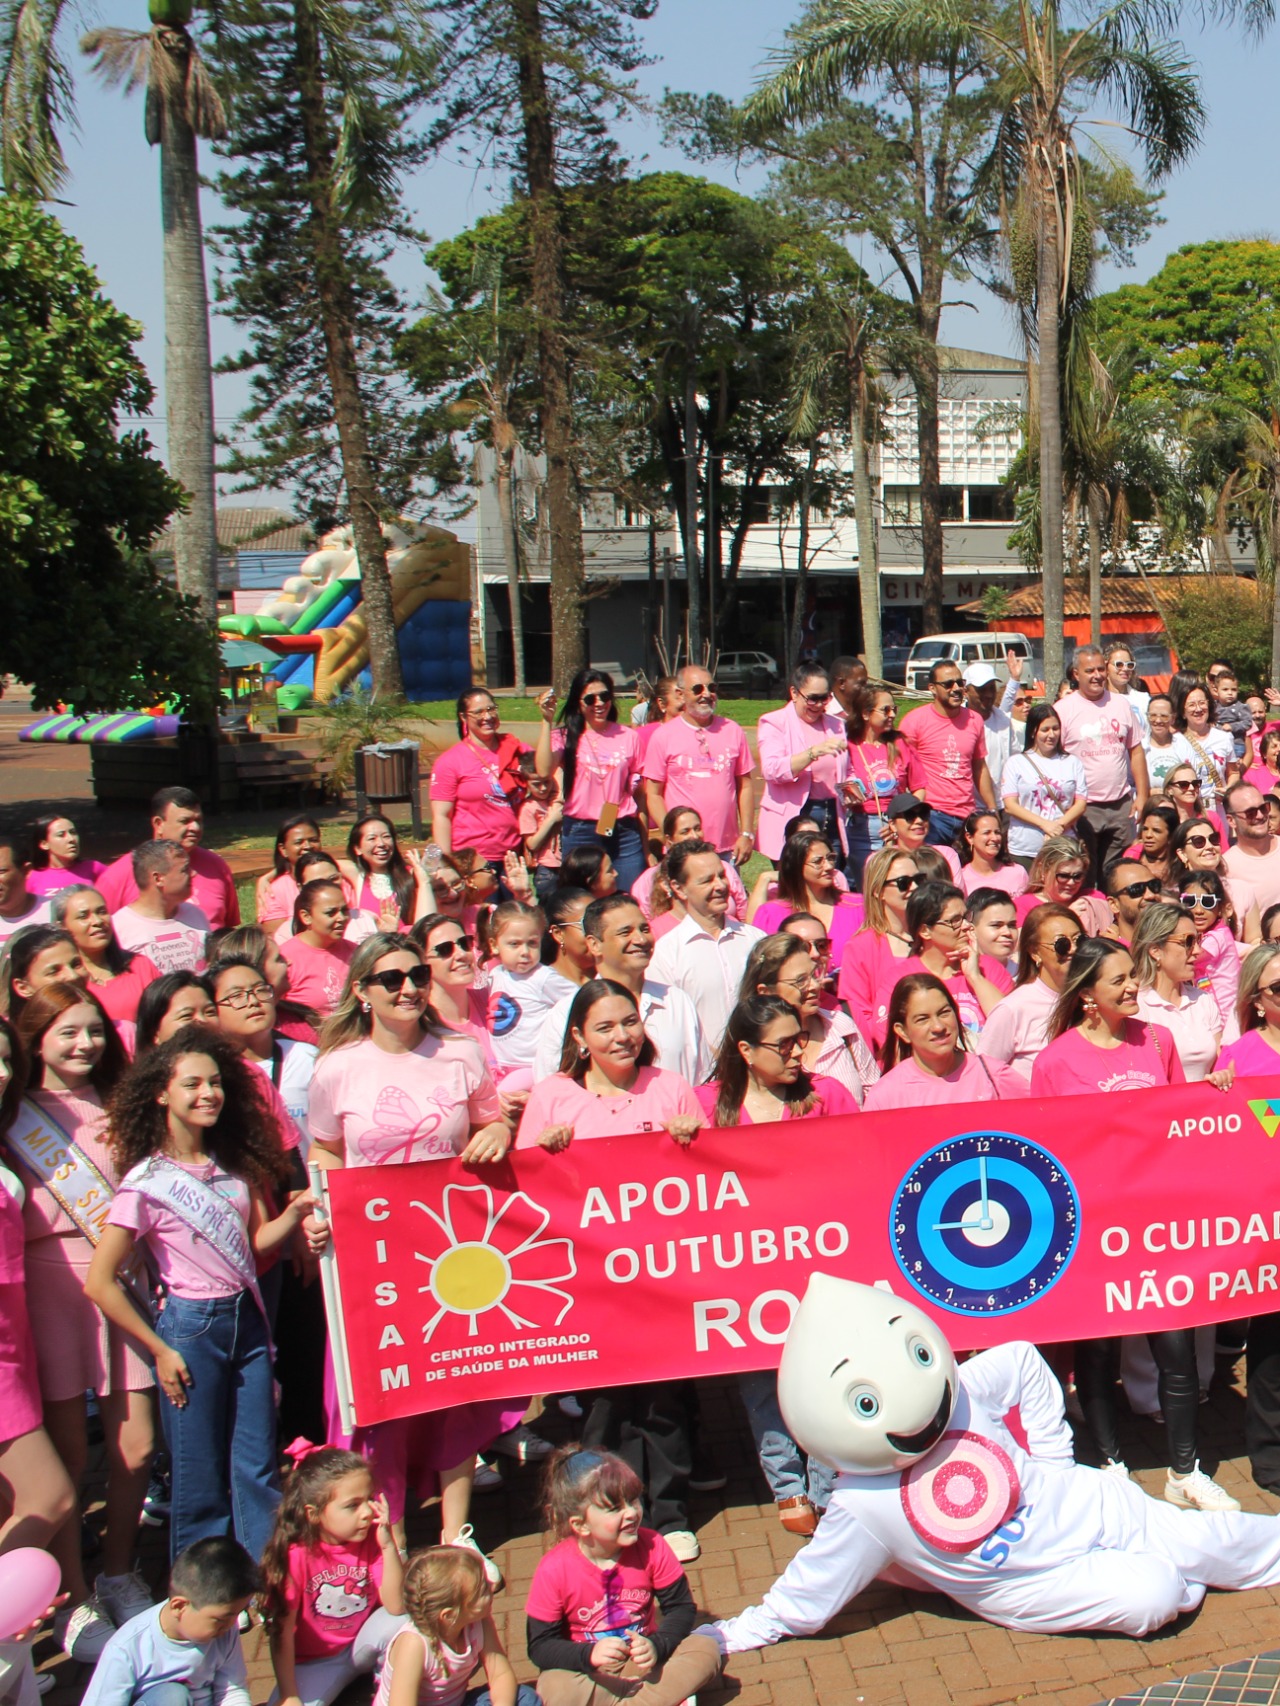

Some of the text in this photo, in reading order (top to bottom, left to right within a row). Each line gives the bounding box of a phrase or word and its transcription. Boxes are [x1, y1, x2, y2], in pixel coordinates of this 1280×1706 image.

[885, 581, 945, 600] CIN
[1167, 1113, 1242, 1139] APOIO
[976, 1141, 990, 1152] 12
[1020, 1147, 1027, 1157] 1
[22, 1126, 78, 1181] MISS
[938, 1151, 951, 1162] 11
[1050, 1171, 1059, 1182] 2
[907, 1181, 922, 1193] 10
[168, 1179, 204, 1213] MISS
[579, 1171, 750, 1229] APOIA
[1066, 1211, 1073, 1222] 3
[897, 1223, 906, 1235] 9
[1100, 1225, 1130, 1257] O
[604, 1221, 849, 1283] OUTUBRO
[1054, 1251, 1062, 1262] 4
[914, 1260, 922, 1272] 8
[1029, 1278, 1036, 1289] 5
[946, 1288, 954, 1300] 7
[1105, 1269, 1194, 1313] NÃO
[987, 1294, 995, 1306] 6
[430, 1333, 591, 1363] CENTRO INTEGRADO
[425, 1349, 599, 1382] DE SAÚDE DA MULHER
[980, 1503, 1034, 1569] SU
